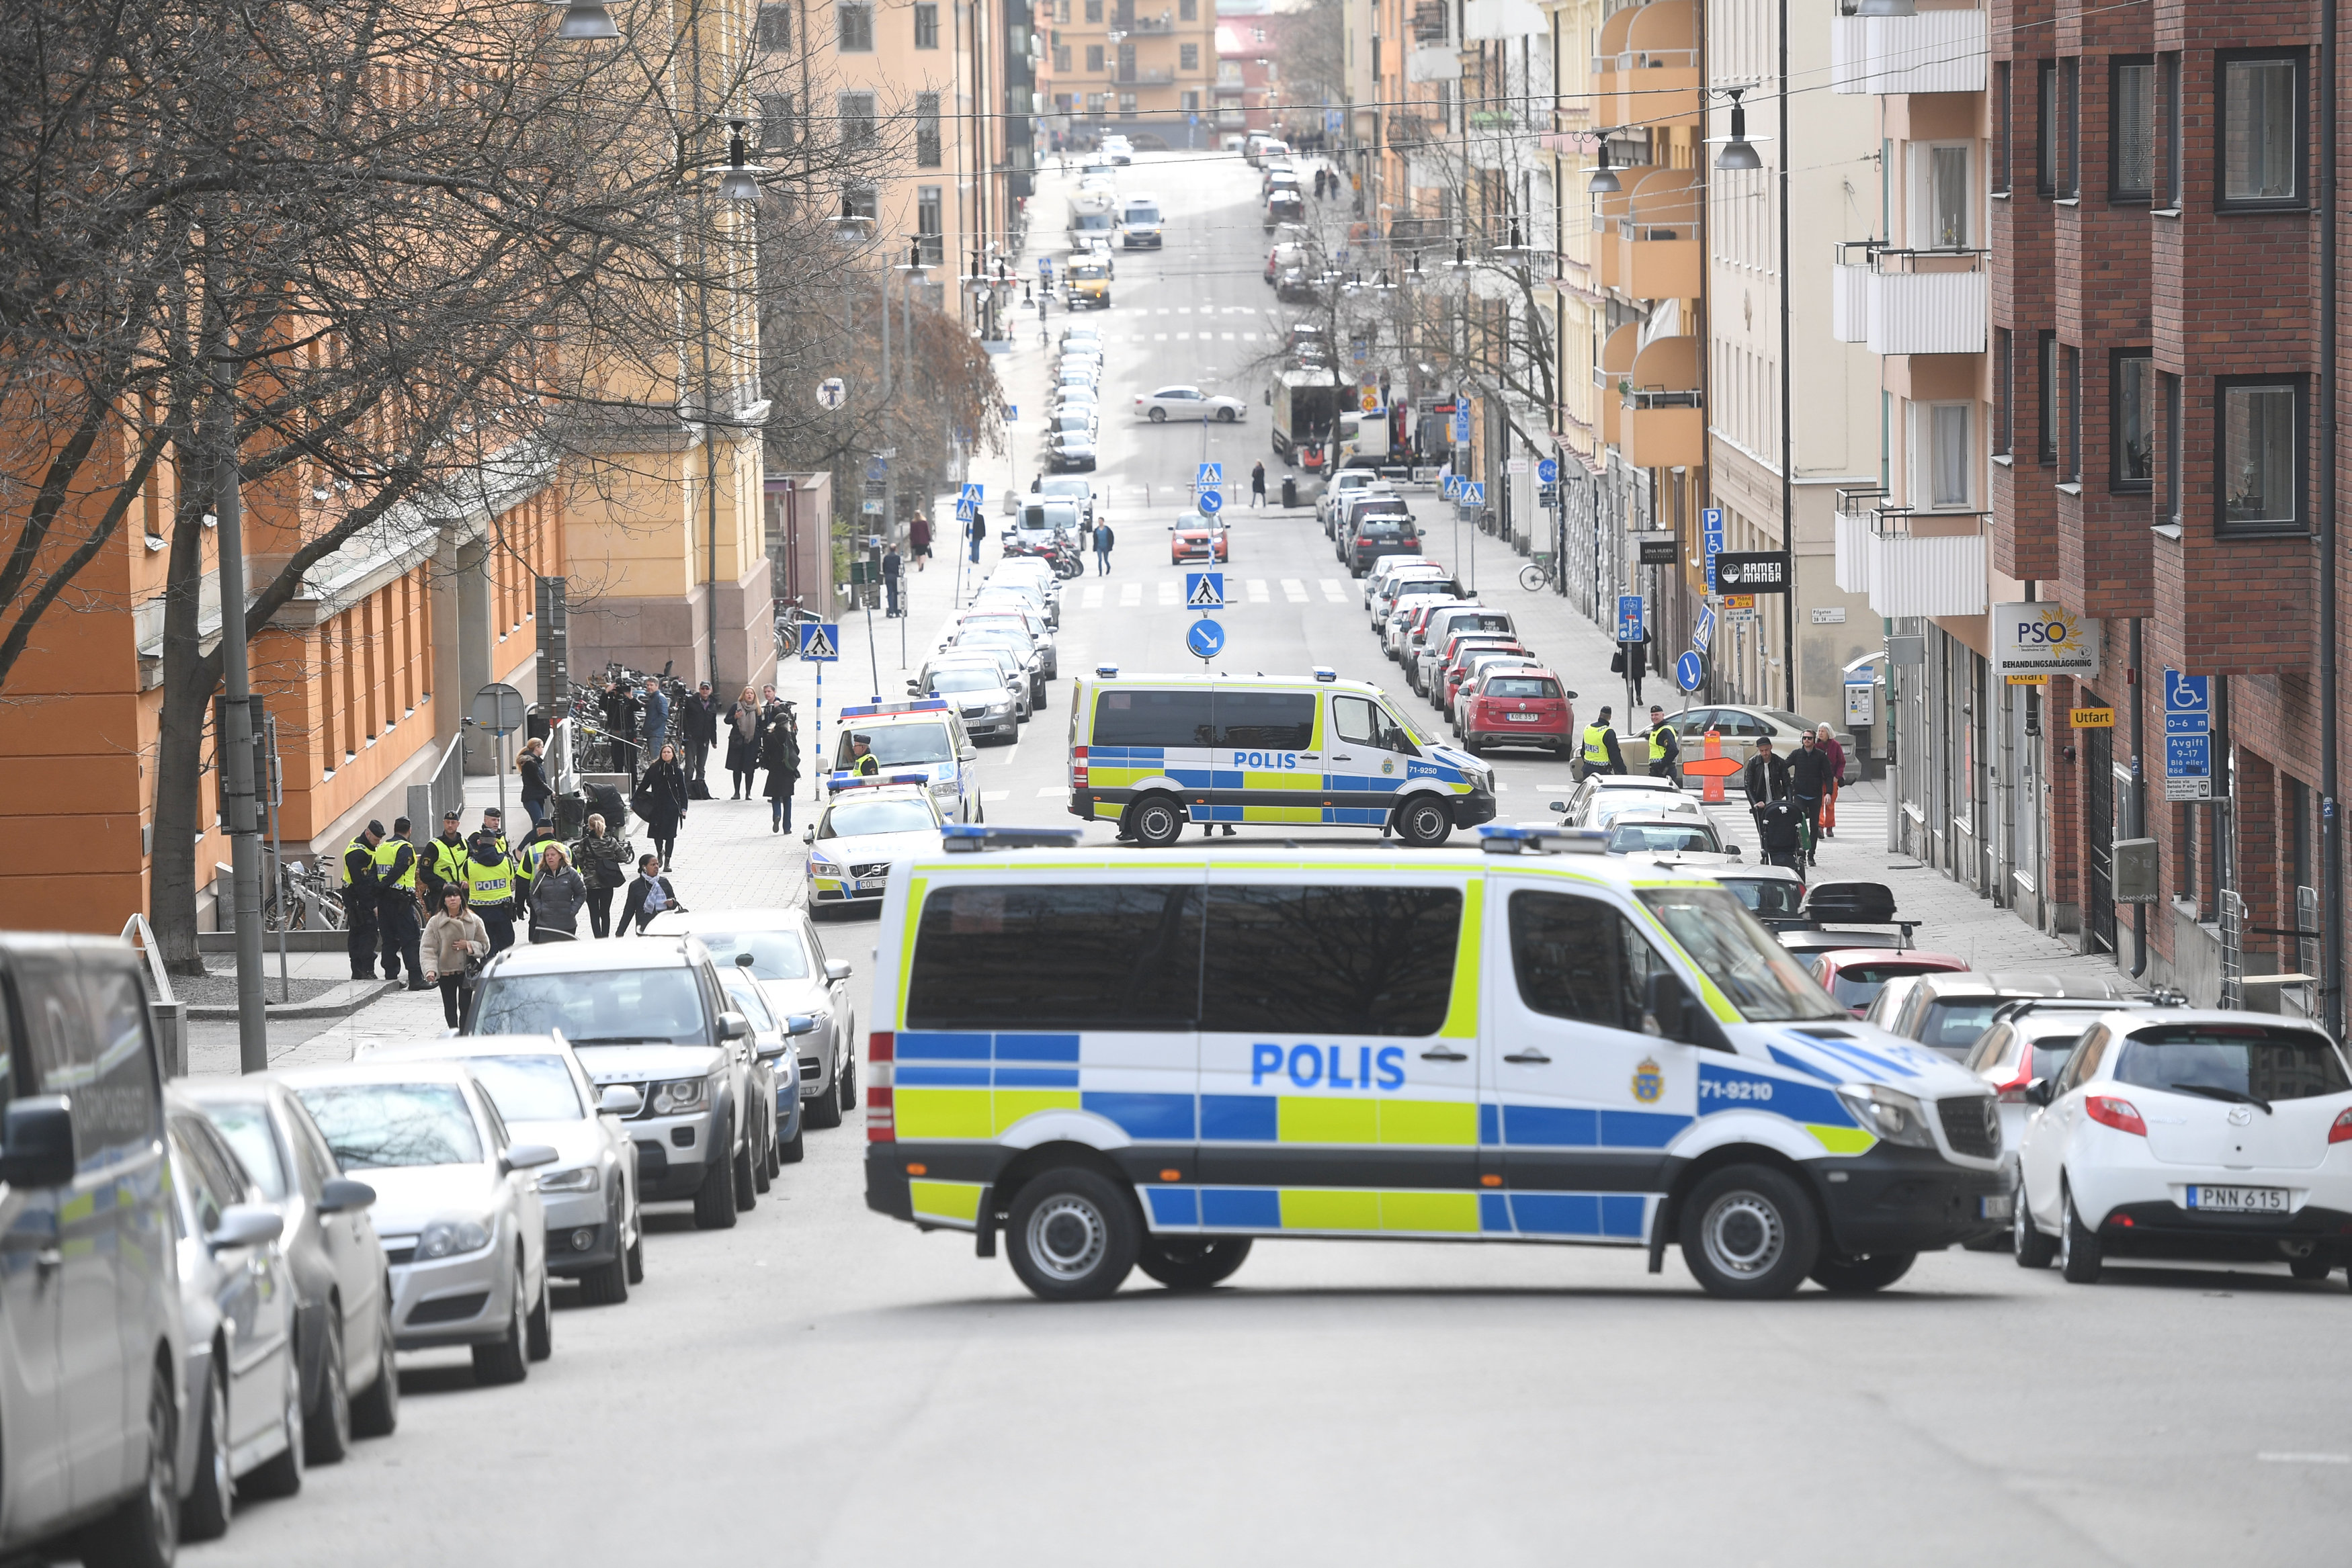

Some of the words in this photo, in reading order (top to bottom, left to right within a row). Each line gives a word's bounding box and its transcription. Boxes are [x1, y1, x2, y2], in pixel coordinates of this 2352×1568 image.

[823, 386, 840, 406] T
[1459, 399, 1467, 410] P
[1708, 511, 1719, 530] P
[1743, 562, 1781, 573] RAMEN
[1743, 572, 1781, 583] MANGA
[2018, 621, 2066, 644] PSO
[2002, 658, 2092, 668] BEHANDLINGSANLÄGGNING
[2075, 712, 2109, 723] Utfart
[1585, 743, 1599, 753] OLIS
[2171, 739, 2203, 748] Avgift
[2177, 750, 2198, 758] 9-17
[1234, 752, 1296, 770] POLIS
[1409, 766, 1437, 775] 71-9250
[376, 865, 392, 874] OLIS
[476, 879, 505, 890] POLIS
[1252, 1043, 1405, 1091] POLIS
[1699, 1079, 1773, 1101] 71-9210
[2203, 1188, 2238, 1207] PNN
[2244, 1190, 2281, 1209] 615
